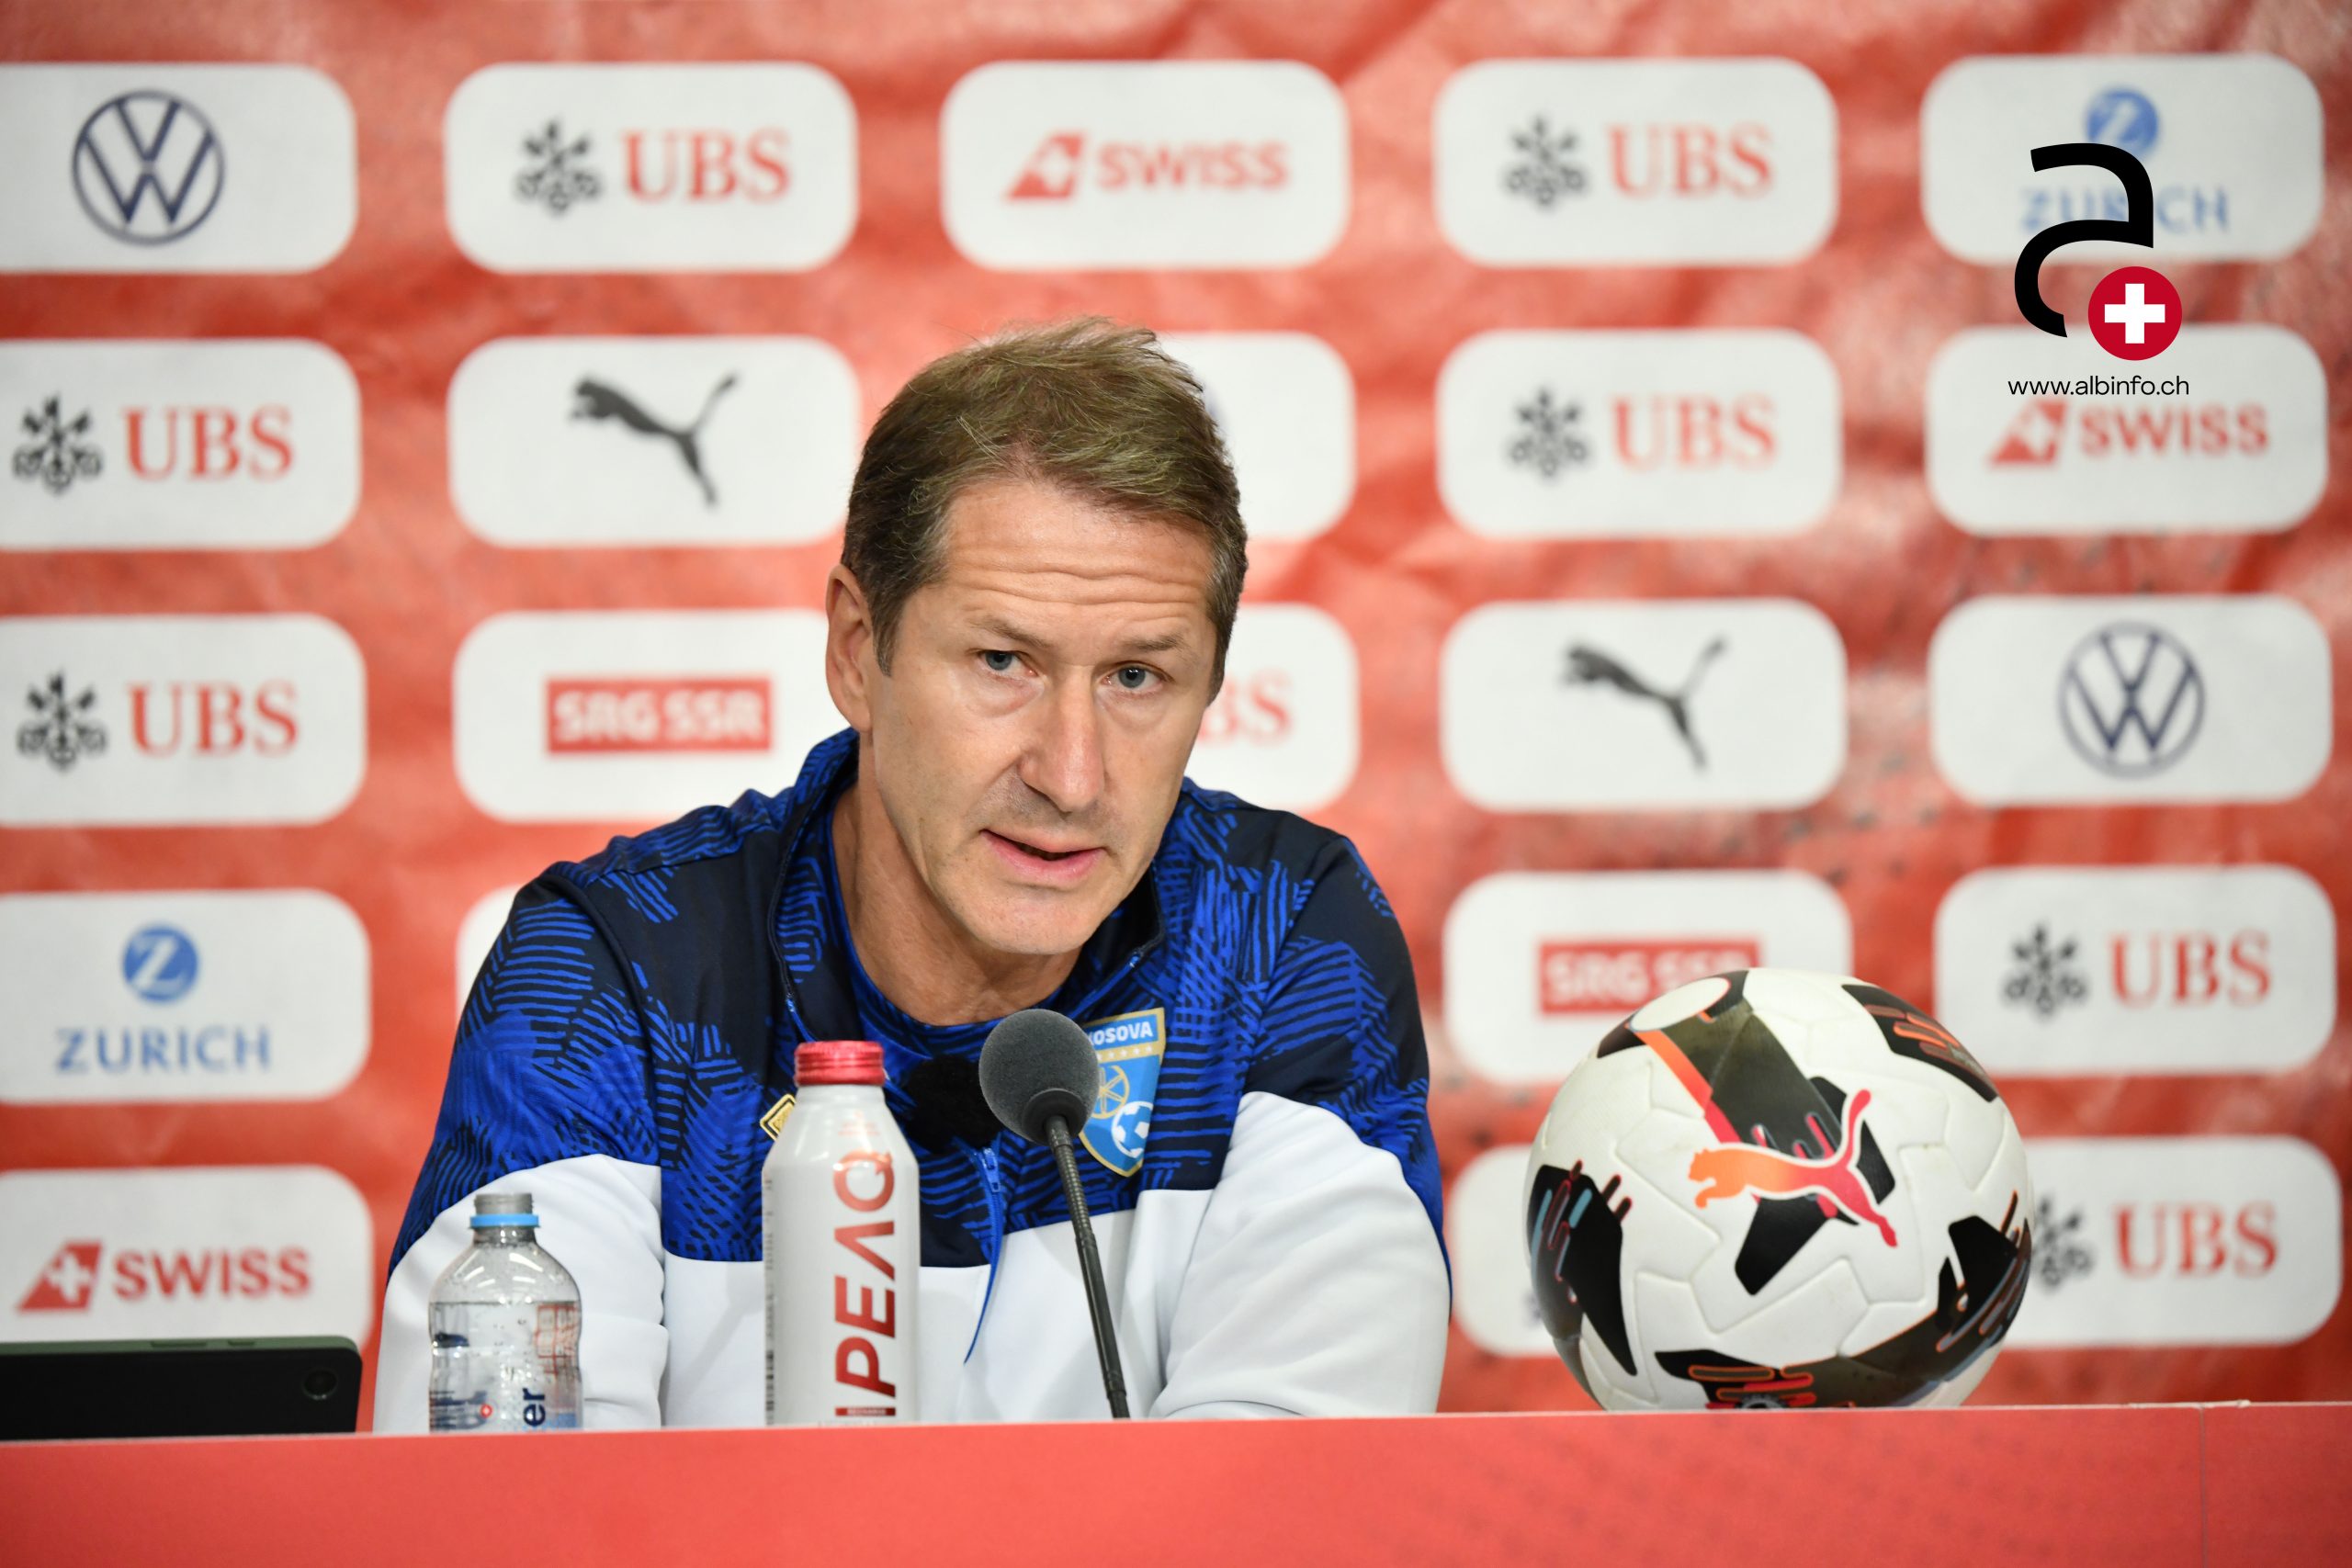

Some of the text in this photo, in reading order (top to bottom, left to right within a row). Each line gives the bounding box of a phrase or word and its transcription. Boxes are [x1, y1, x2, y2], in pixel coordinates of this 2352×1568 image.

[622, 130, 791, 203] UBS
[1095, 141, 1291, 192] SWISS
[1609, 125, 1775, 197] UBS
[2021, 184, 2231, 233] ZURCH
[123, 407, 293, 479] UBS
[1610, 395, 1777, 468] UBS
[2079, 404, 2272, 457] SWISS
[128, 683, 299, 756] UBS
[554, 689, 765, 742] SRG SSR
[1544, 951, 1650, 1005] SRG
[2110, 932, 2273, 1006] UBS
[53, 1027, 270, 1076] ZURICH
[2114, 1204, 2280, 1278] UBS
[113, 1248, 311, 1303] SWISS
